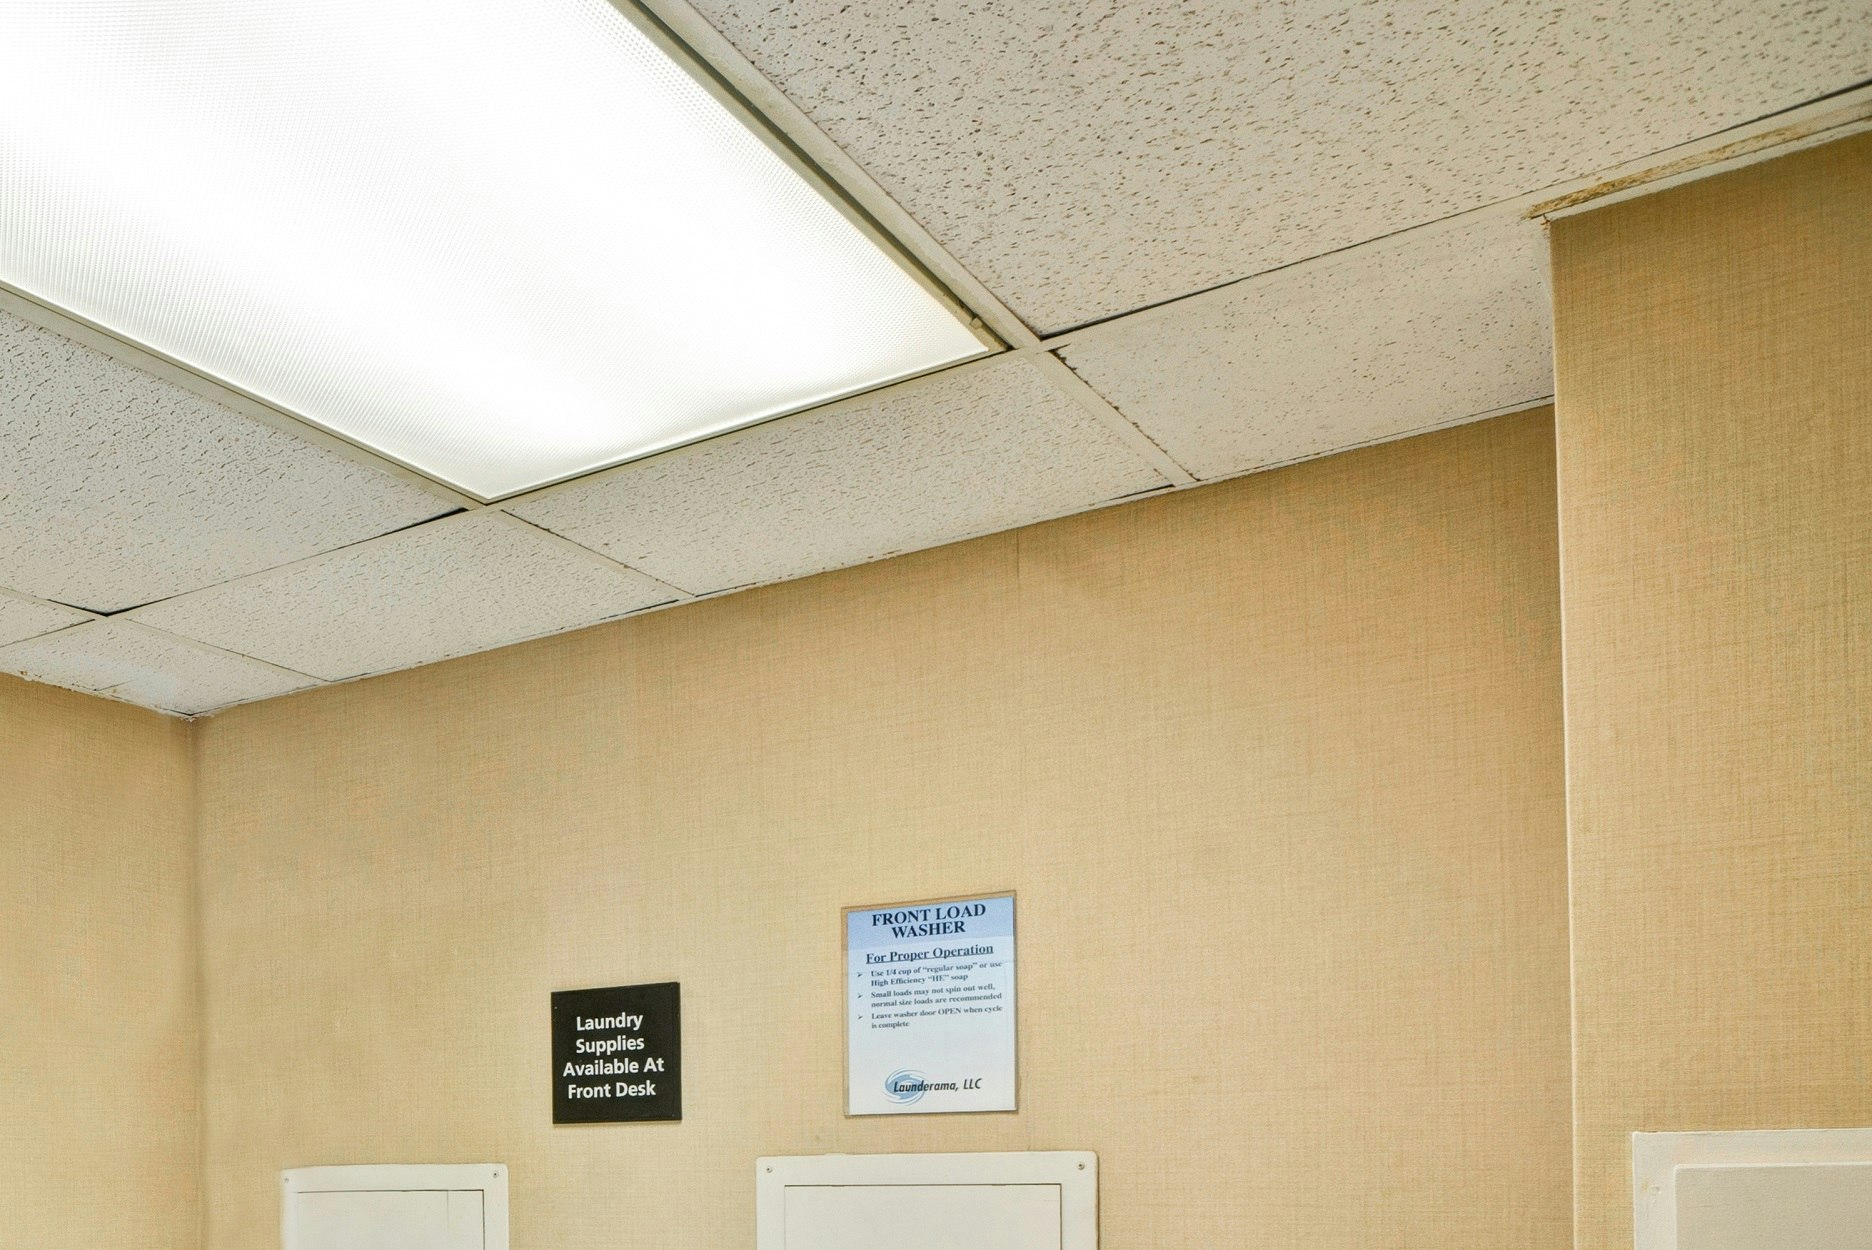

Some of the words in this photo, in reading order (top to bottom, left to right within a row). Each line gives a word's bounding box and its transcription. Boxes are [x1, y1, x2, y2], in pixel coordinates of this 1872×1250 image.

[872, 909, 930, 926] FRONT
[936, 904, 986, 920] LOAD
[892, 921, 966, 938] WASHER
[866, 953, 886, 963] For
[890, 951, 929, 962] Proper
[933, 945, 993, 959] Operation
[891, 977, 925, 985] Efficiency
[949, 993, 1002, 1002] recommended
[577, 1012, 643, 1031] Laundry
[879, 1021, 909, 1029] complete
[576, 1036, 644, 1056] Supplies
[563, 1058, 639, 1077] Available
[644, 1058, 664, 1072] At
[568, 1084, 611, 1099] Front
[616, 1080, 656, 1097] Desk
[894, 1080, 959, 1092] Launderama,
[964, 1078, 982, 1089] LLC
